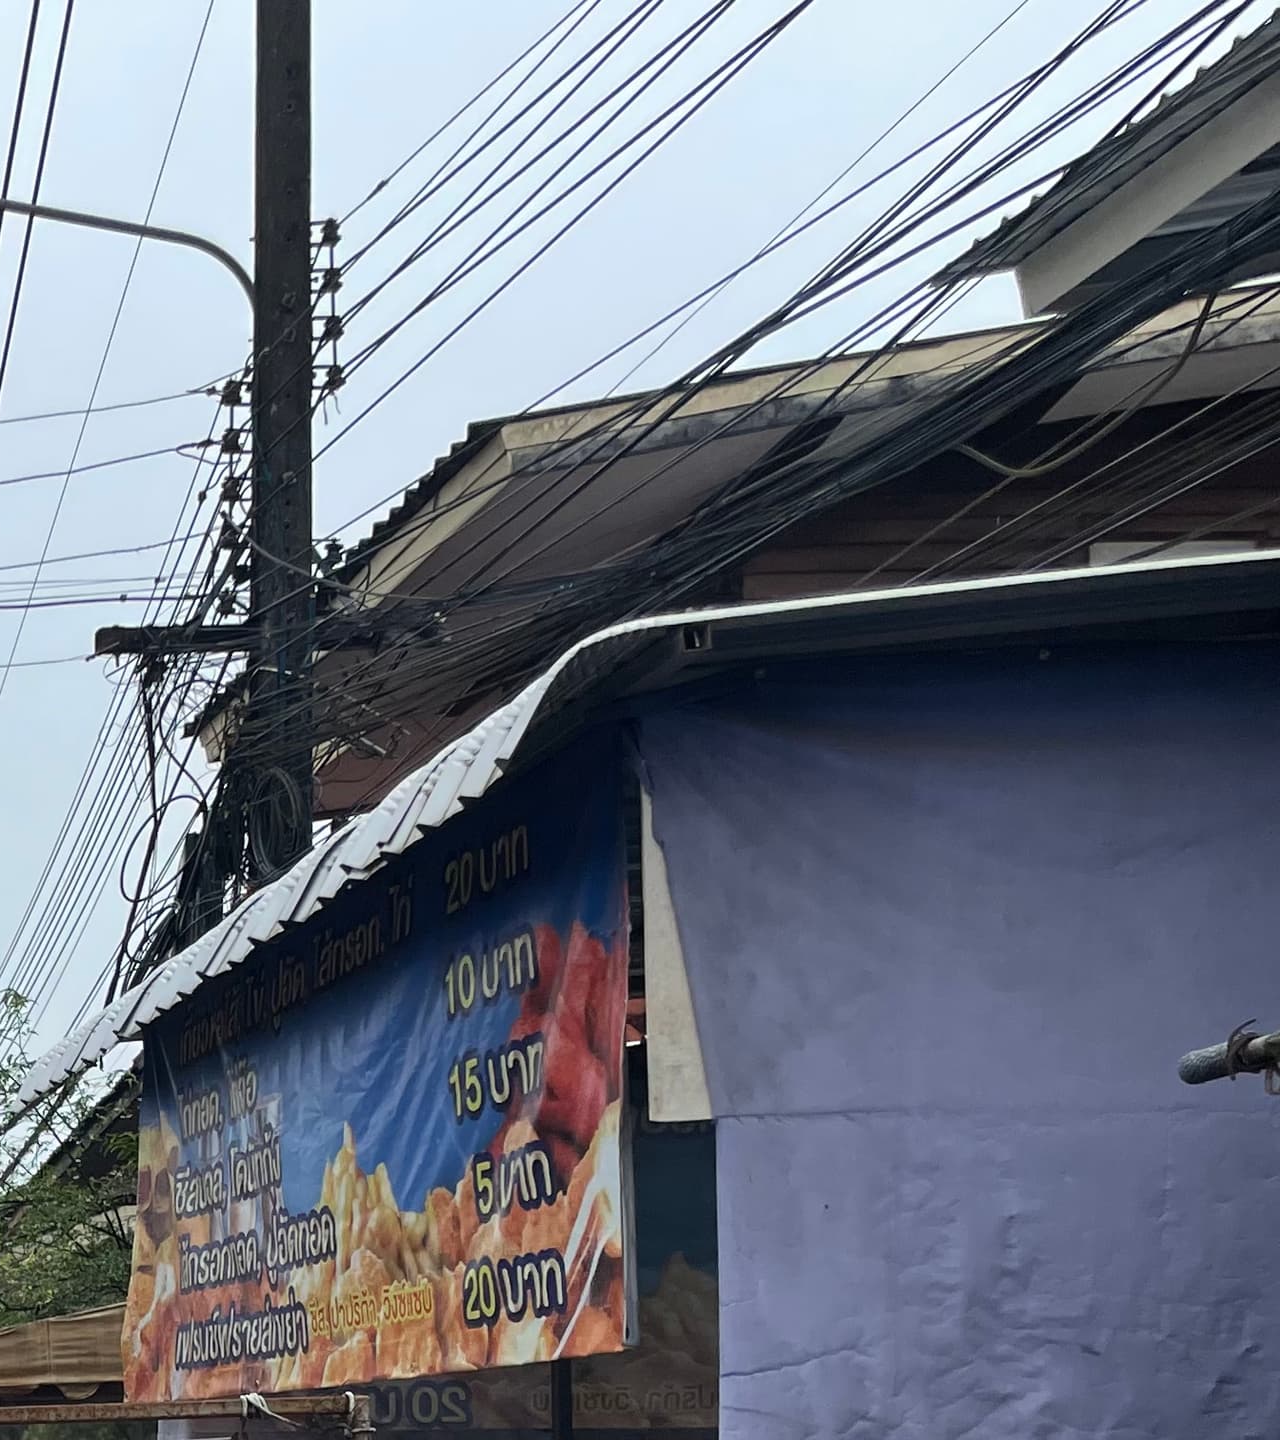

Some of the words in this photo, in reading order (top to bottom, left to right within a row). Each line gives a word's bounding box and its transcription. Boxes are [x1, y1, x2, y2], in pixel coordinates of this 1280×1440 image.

[445, 848, 473, 914] 20
[475, 824, 530, 890] บาท
[444, 955, 475, 1016] 10
[480, 931, 535, 999] บาท
[448, 1064, 481, 1119] 15
[486, 1041, 545, 1106] บาท
[474, 1166, 493, 1218] 5
[462, 1262, 497, 1324] 20
[500, 1253, 566, 1312] บาท
